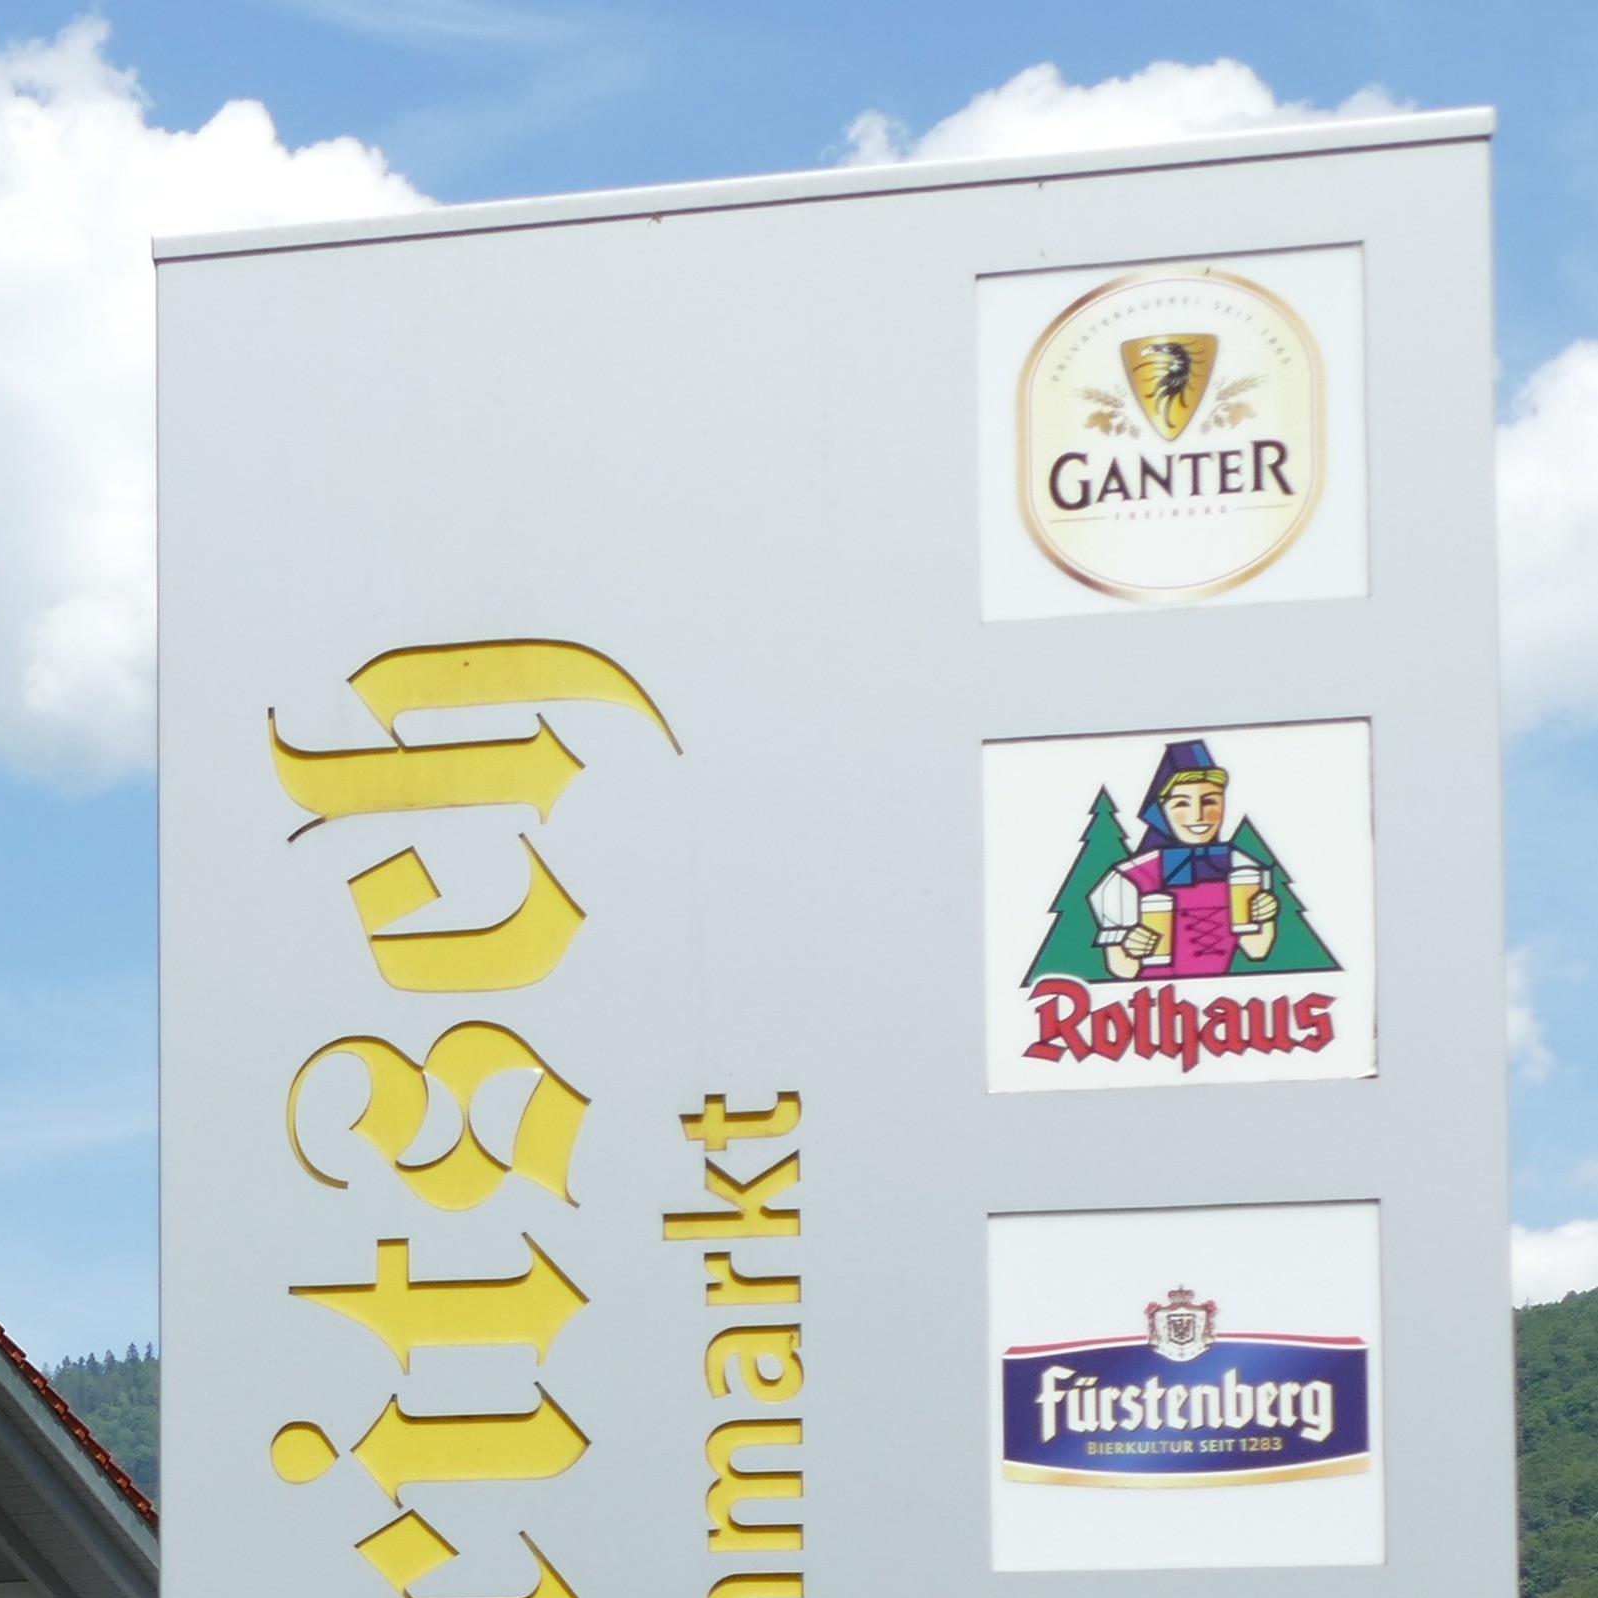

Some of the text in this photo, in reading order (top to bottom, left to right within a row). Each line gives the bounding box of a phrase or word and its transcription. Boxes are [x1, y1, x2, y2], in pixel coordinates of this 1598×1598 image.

[1213, 301, 1254, 324] SEIT
[1049, 438, 1296, 511] GANTER
[1114, 505, 1228, 521] FREIBURG
[1021, 975, 1339, 1074] Rothaus
[1034, 1363, 1335, 1445] Fürstenberg
[1086, 1434, 1283, 1457] BIERKULTUR SEIT 1283
